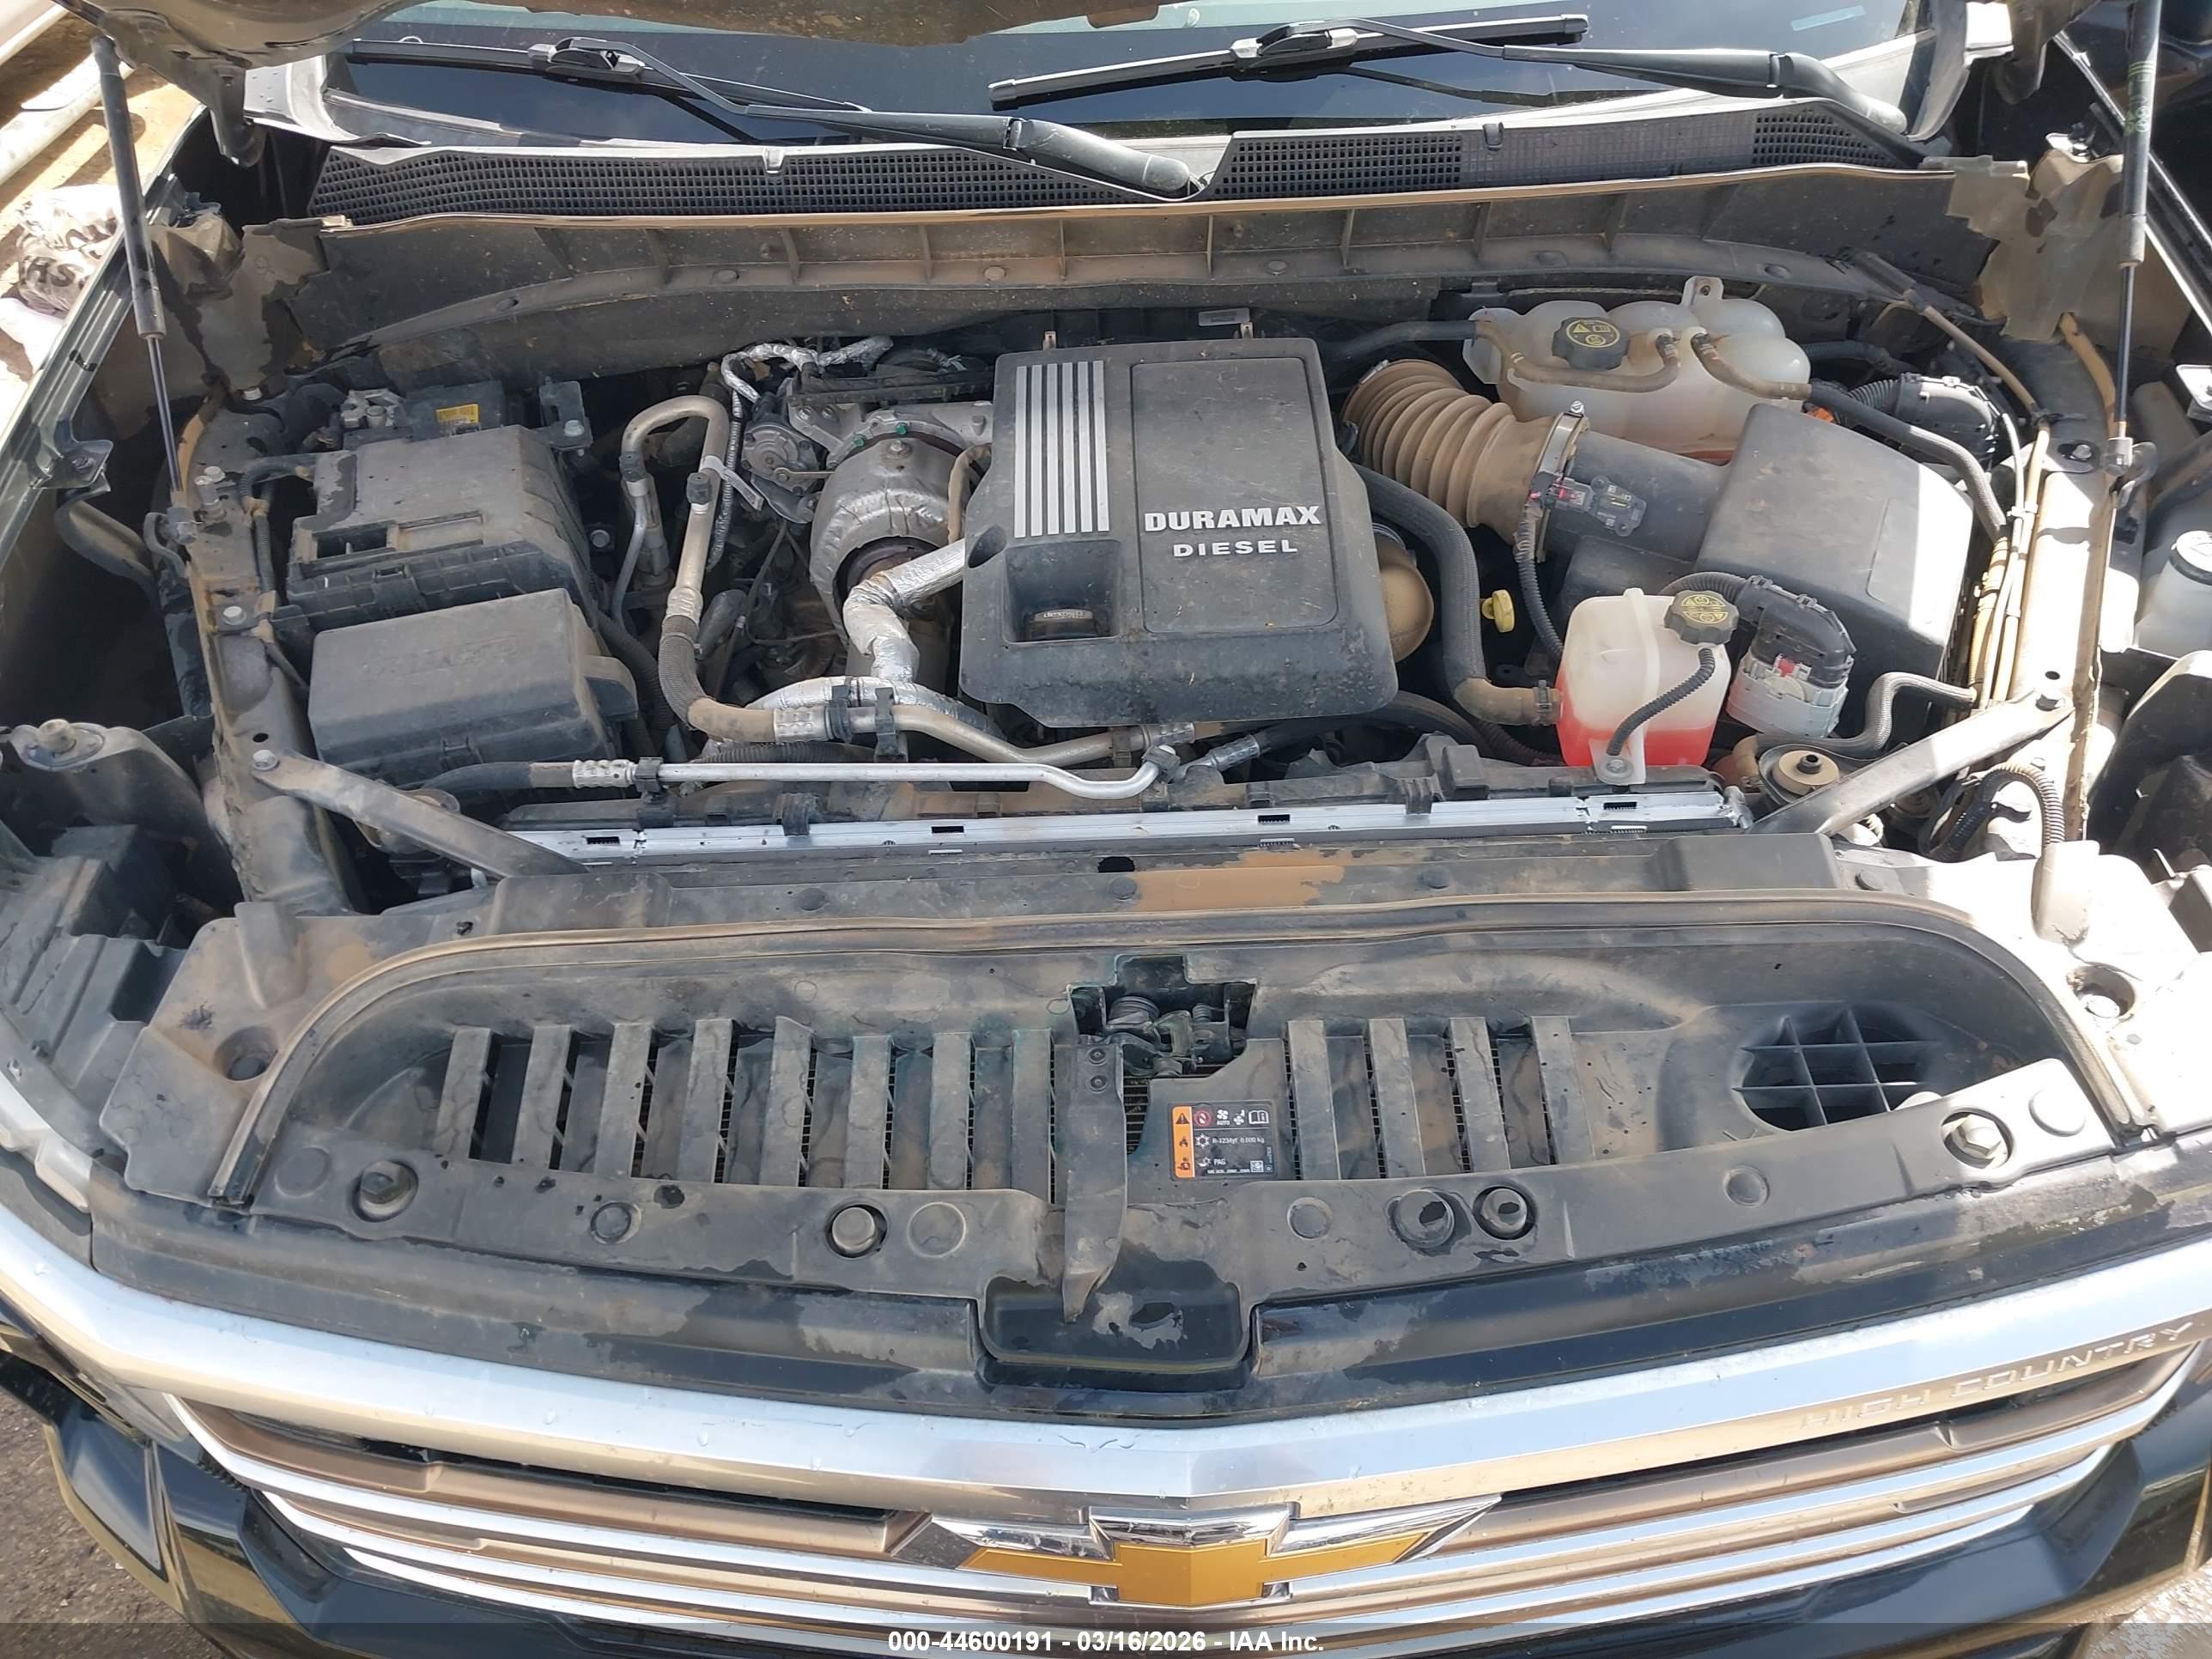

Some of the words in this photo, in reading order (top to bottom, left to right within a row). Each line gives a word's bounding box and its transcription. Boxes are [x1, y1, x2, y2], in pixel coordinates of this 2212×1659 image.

[1145, 506, 1321, 532] DURAMAX
[1173, 539, 1297, 557] DIESEL
[1800, 1389, 1931, 1430] HIGH
[1951, 1322, 2193, 1398] COUNTRY
